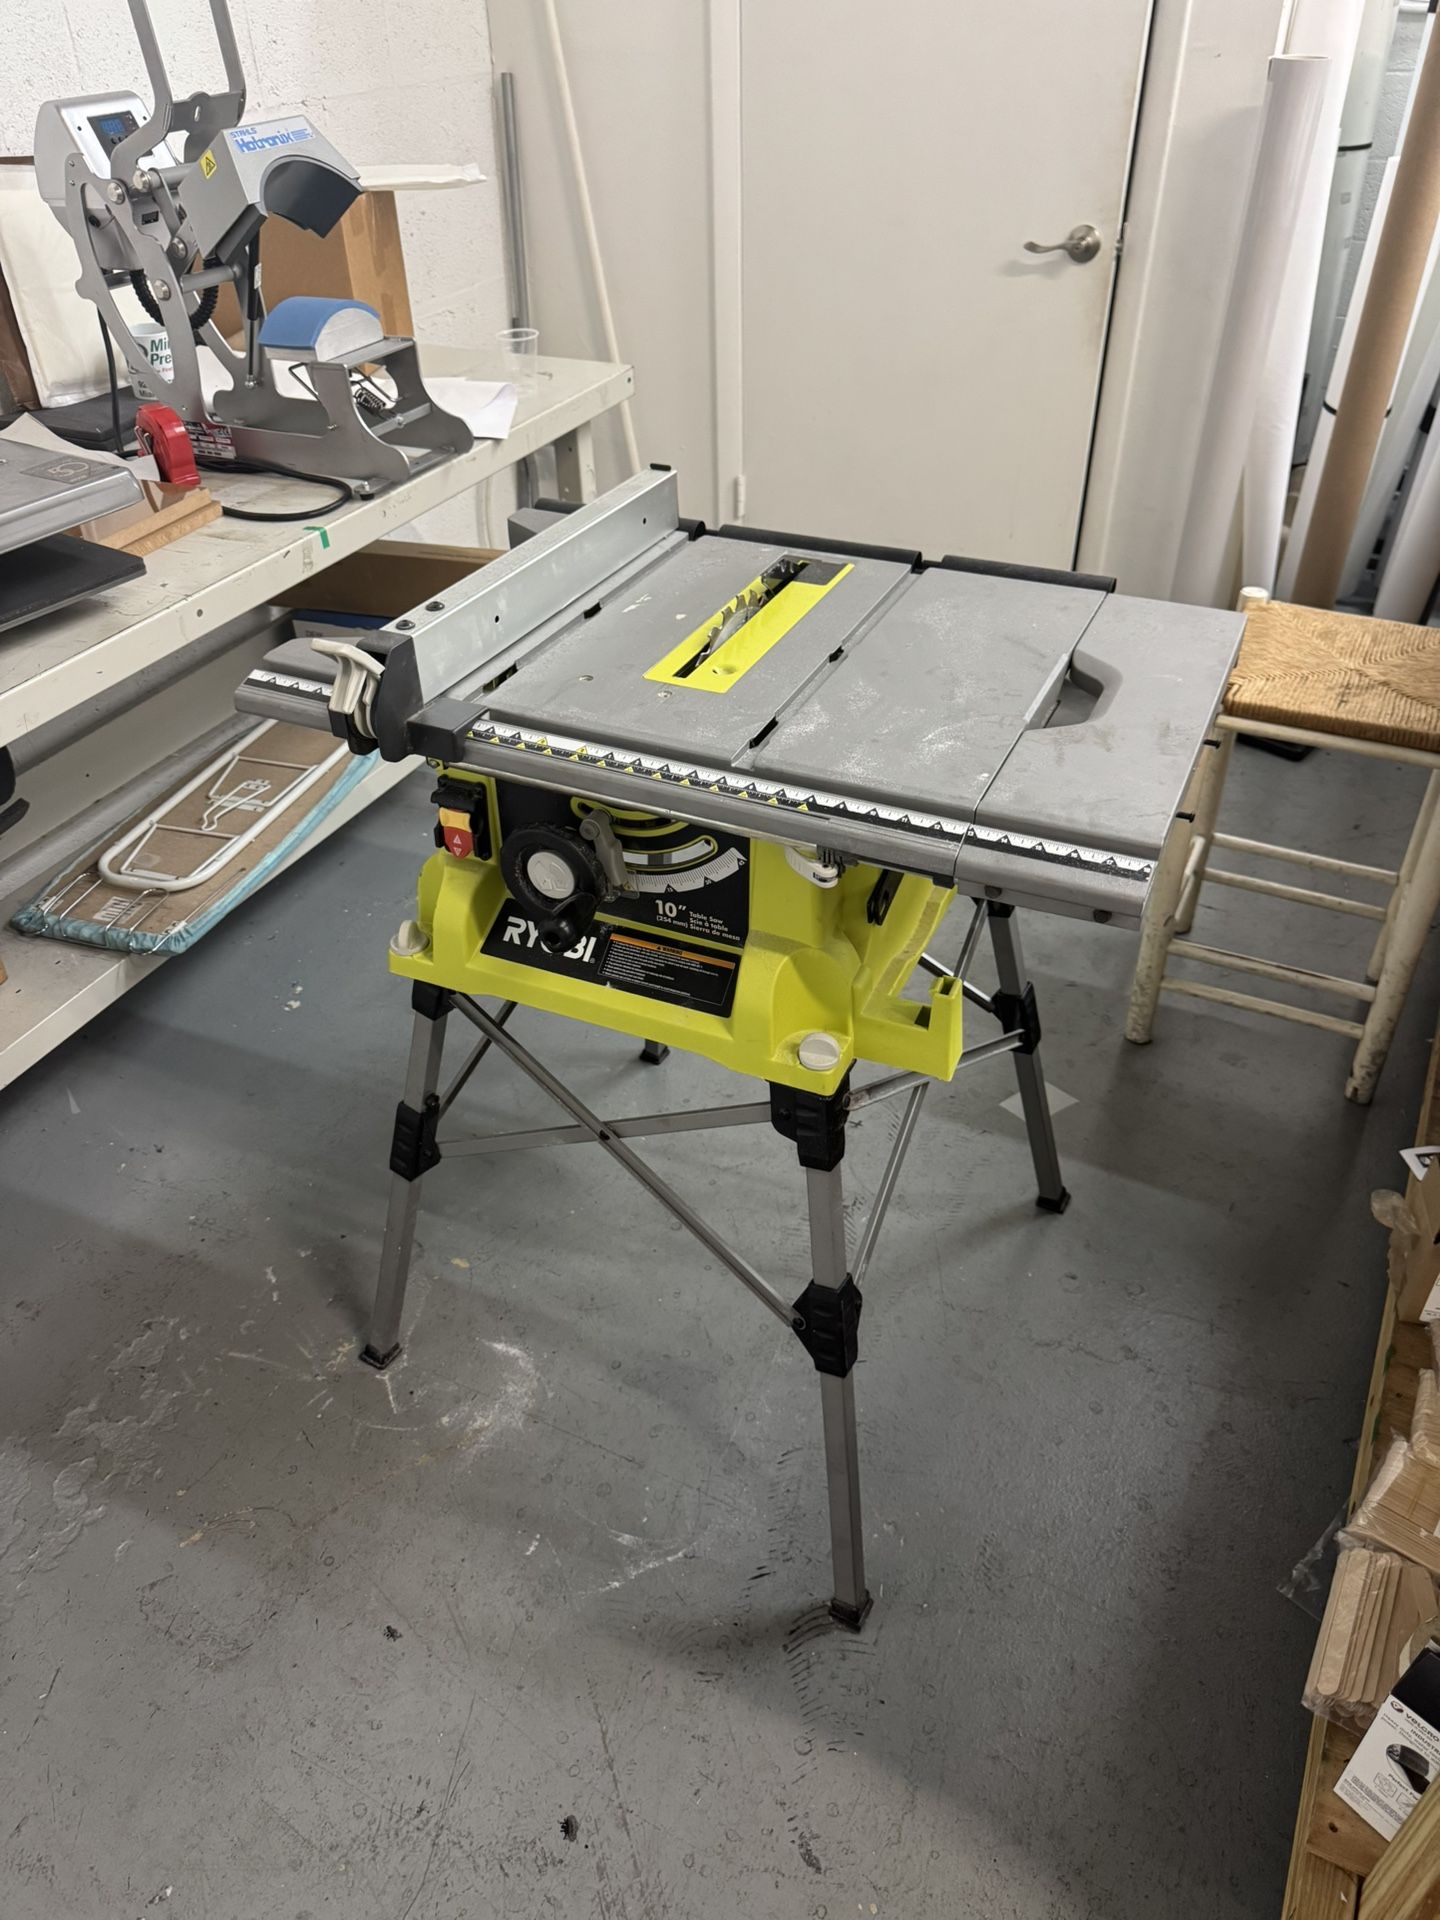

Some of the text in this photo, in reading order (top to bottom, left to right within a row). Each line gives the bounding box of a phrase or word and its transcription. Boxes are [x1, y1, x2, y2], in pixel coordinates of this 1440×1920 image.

[234, 130, 293, 153] Hotronix
[150, 337, 170, 352] Mi
[655, 899, 687, 918] 10"
[689, 910, 724, 924] Table Saw
[710, 922, 729, 932] table
[502, 915, 598, 963] RYBI
